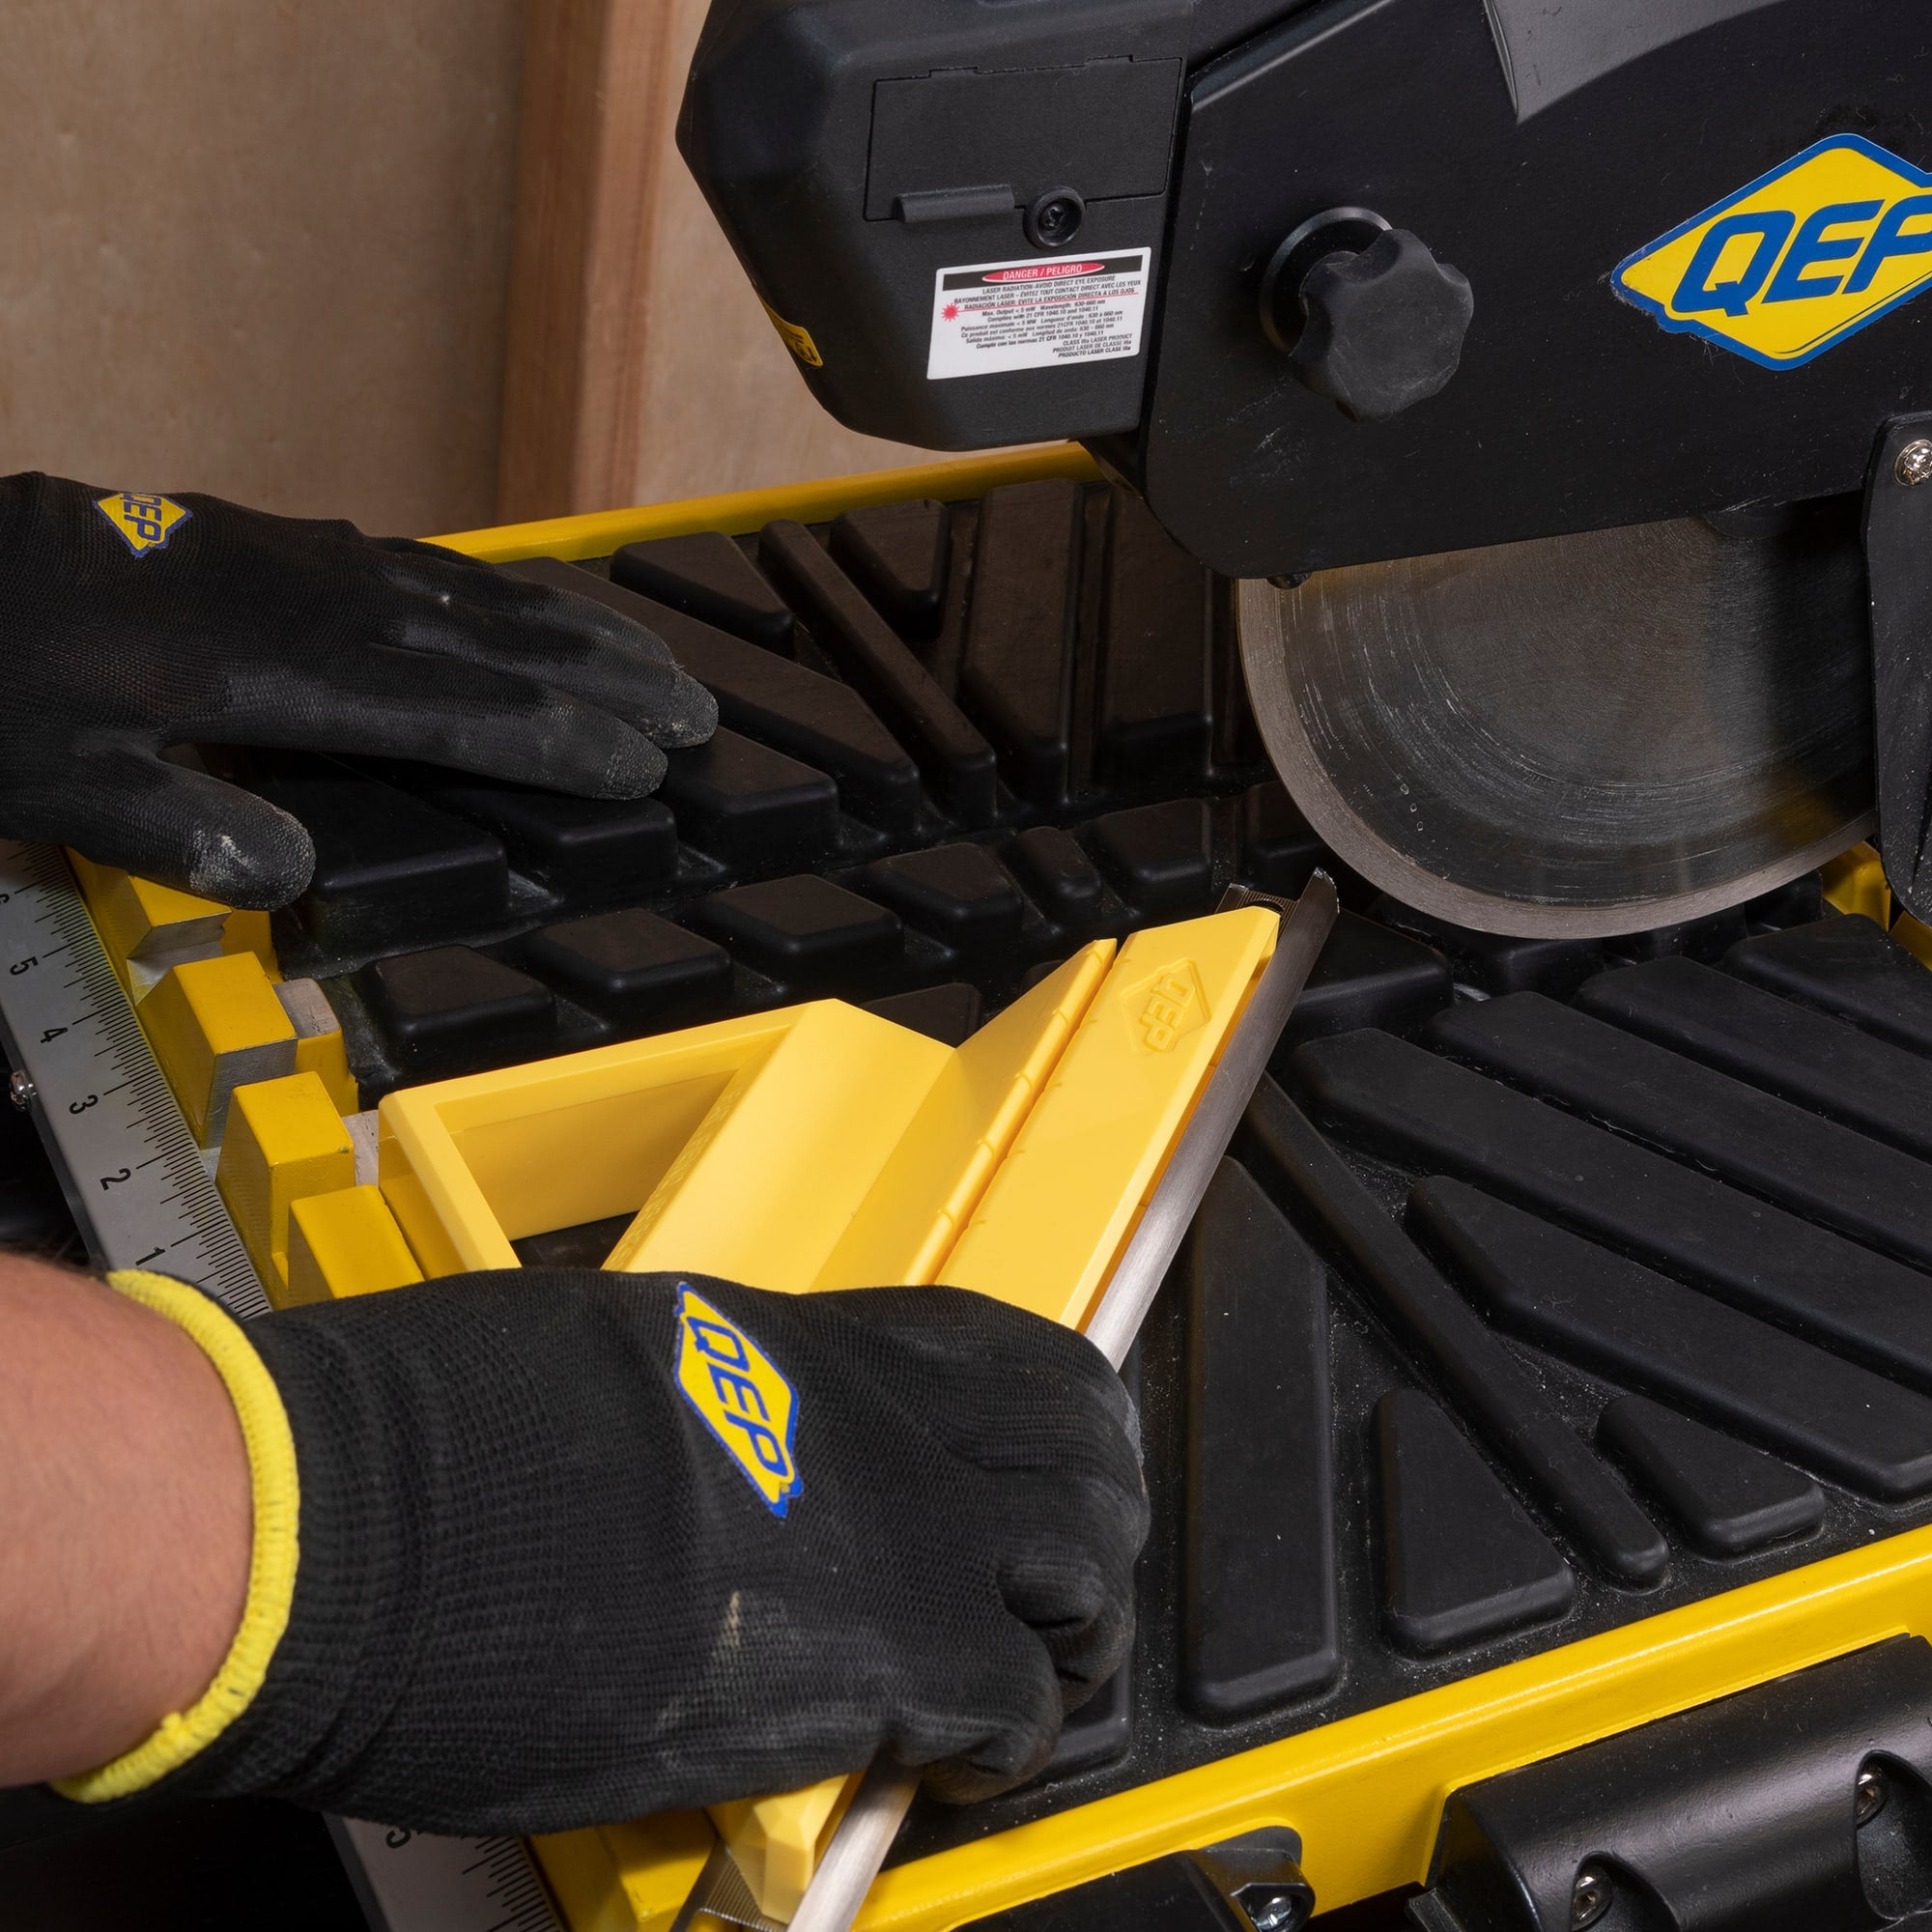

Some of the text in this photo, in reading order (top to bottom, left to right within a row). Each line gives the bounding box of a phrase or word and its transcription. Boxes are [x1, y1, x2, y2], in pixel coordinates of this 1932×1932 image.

[1671, 194, 1932, 317] QEP
[1003, 264, 1082, 280] DANGER / PELIGRO
[954, 295, 995, 304] RAYONNEMENT
[10, 955, 39, 976] 5
[40, 1026, 68, 1043] 4
[69, 1094, 99, 1115] 3
[99, 1167, 131, 1190] 2
[135, 1245, 165, 1266] 1
[686, 1316, 789, 1477] QEP
